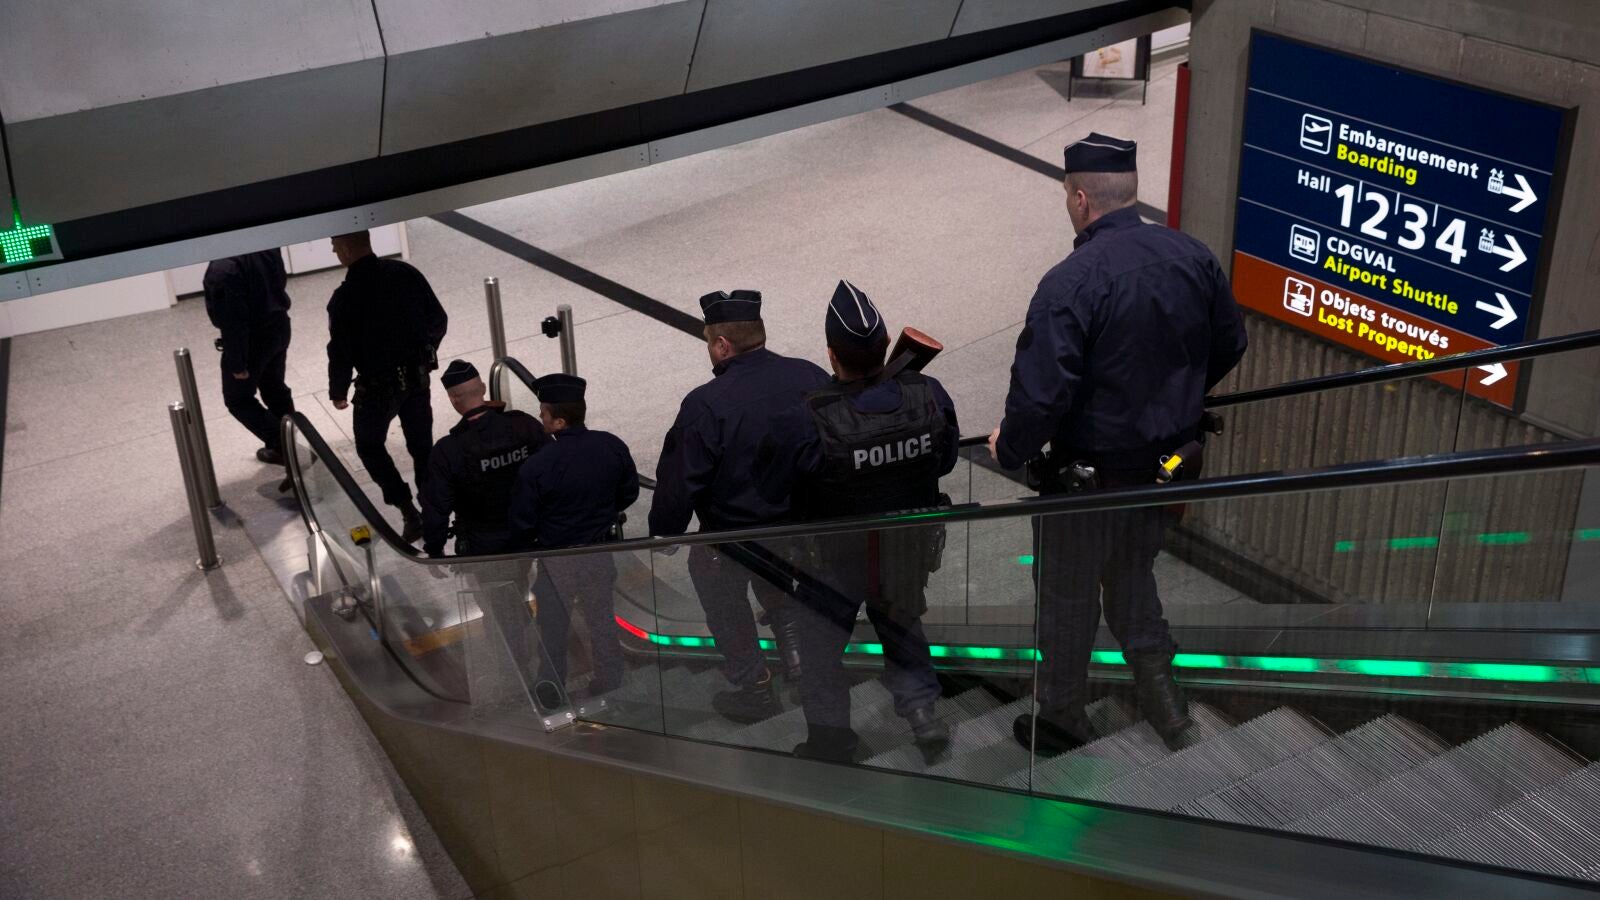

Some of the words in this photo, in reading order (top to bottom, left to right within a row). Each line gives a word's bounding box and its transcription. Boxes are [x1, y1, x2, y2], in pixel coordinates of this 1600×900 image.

[1337, 144, 1417, 185] Boarding
[1338, 124, 1478, 178] Embarquement
[1297, 170, 1330, 193] Hall
[1335, 184, 1355, 227] 1
[1360, 192, 1389, 239] 2
[1398, 203, 1428, 250] 3
[1435, 218, 1467, 264] 4
[1326, 237, 1396, 272] CDGVAL
[1324, 256, 1387, 290] Airport
[1392, 279, 1458, 314] Shuttle
[1318, 308, 1354, 333] Lost
[1320, 290, 1376, 321] Objets
[1381, 312, 1449, 349] trouvés
[480, 446, 529, 472] POLICE
[853, 433, 932, 470] POLICE
